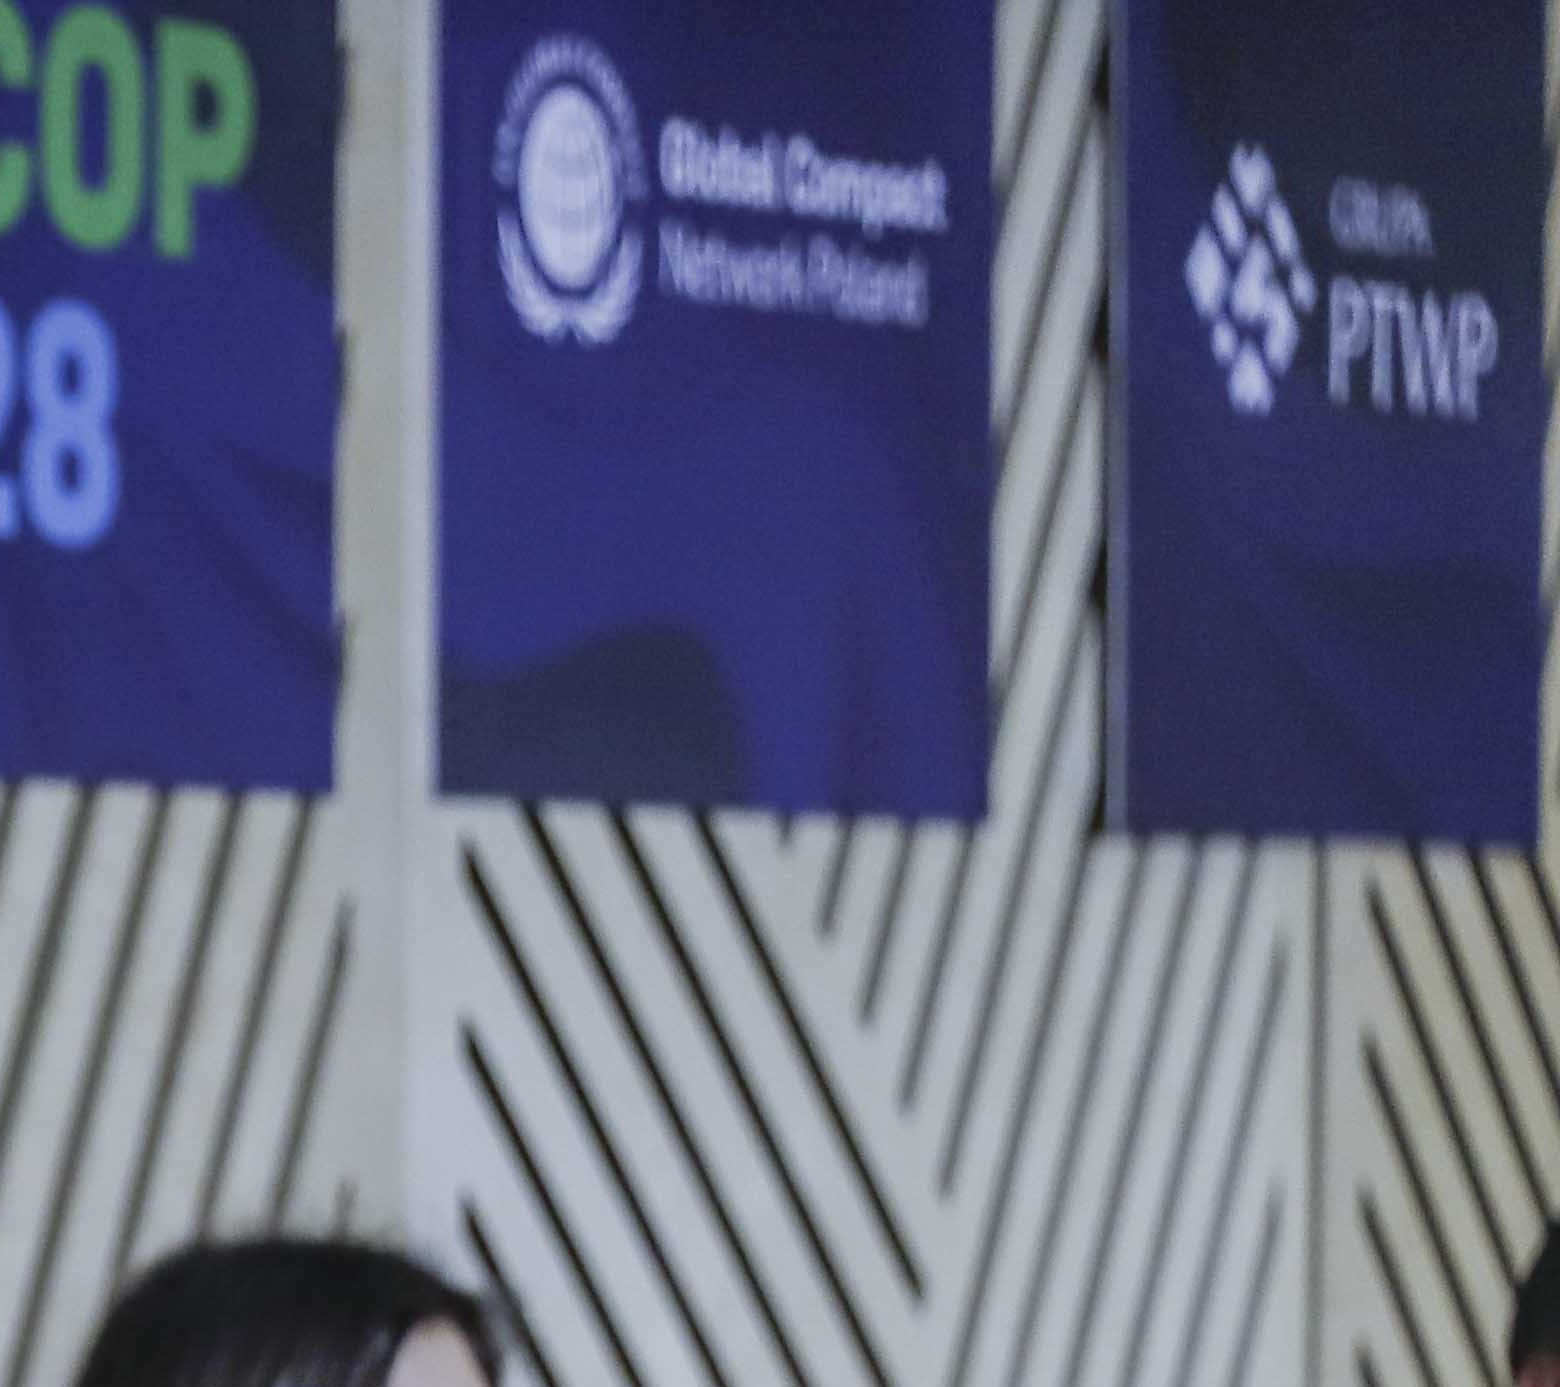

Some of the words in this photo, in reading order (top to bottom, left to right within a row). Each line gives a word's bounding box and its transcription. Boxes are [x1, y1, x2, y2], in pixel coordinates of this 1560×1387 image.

[659, 115, 777, 212] Global
[783, 132, 950, 240] Compact
[1329, 273, 1500, 422] PTWP
